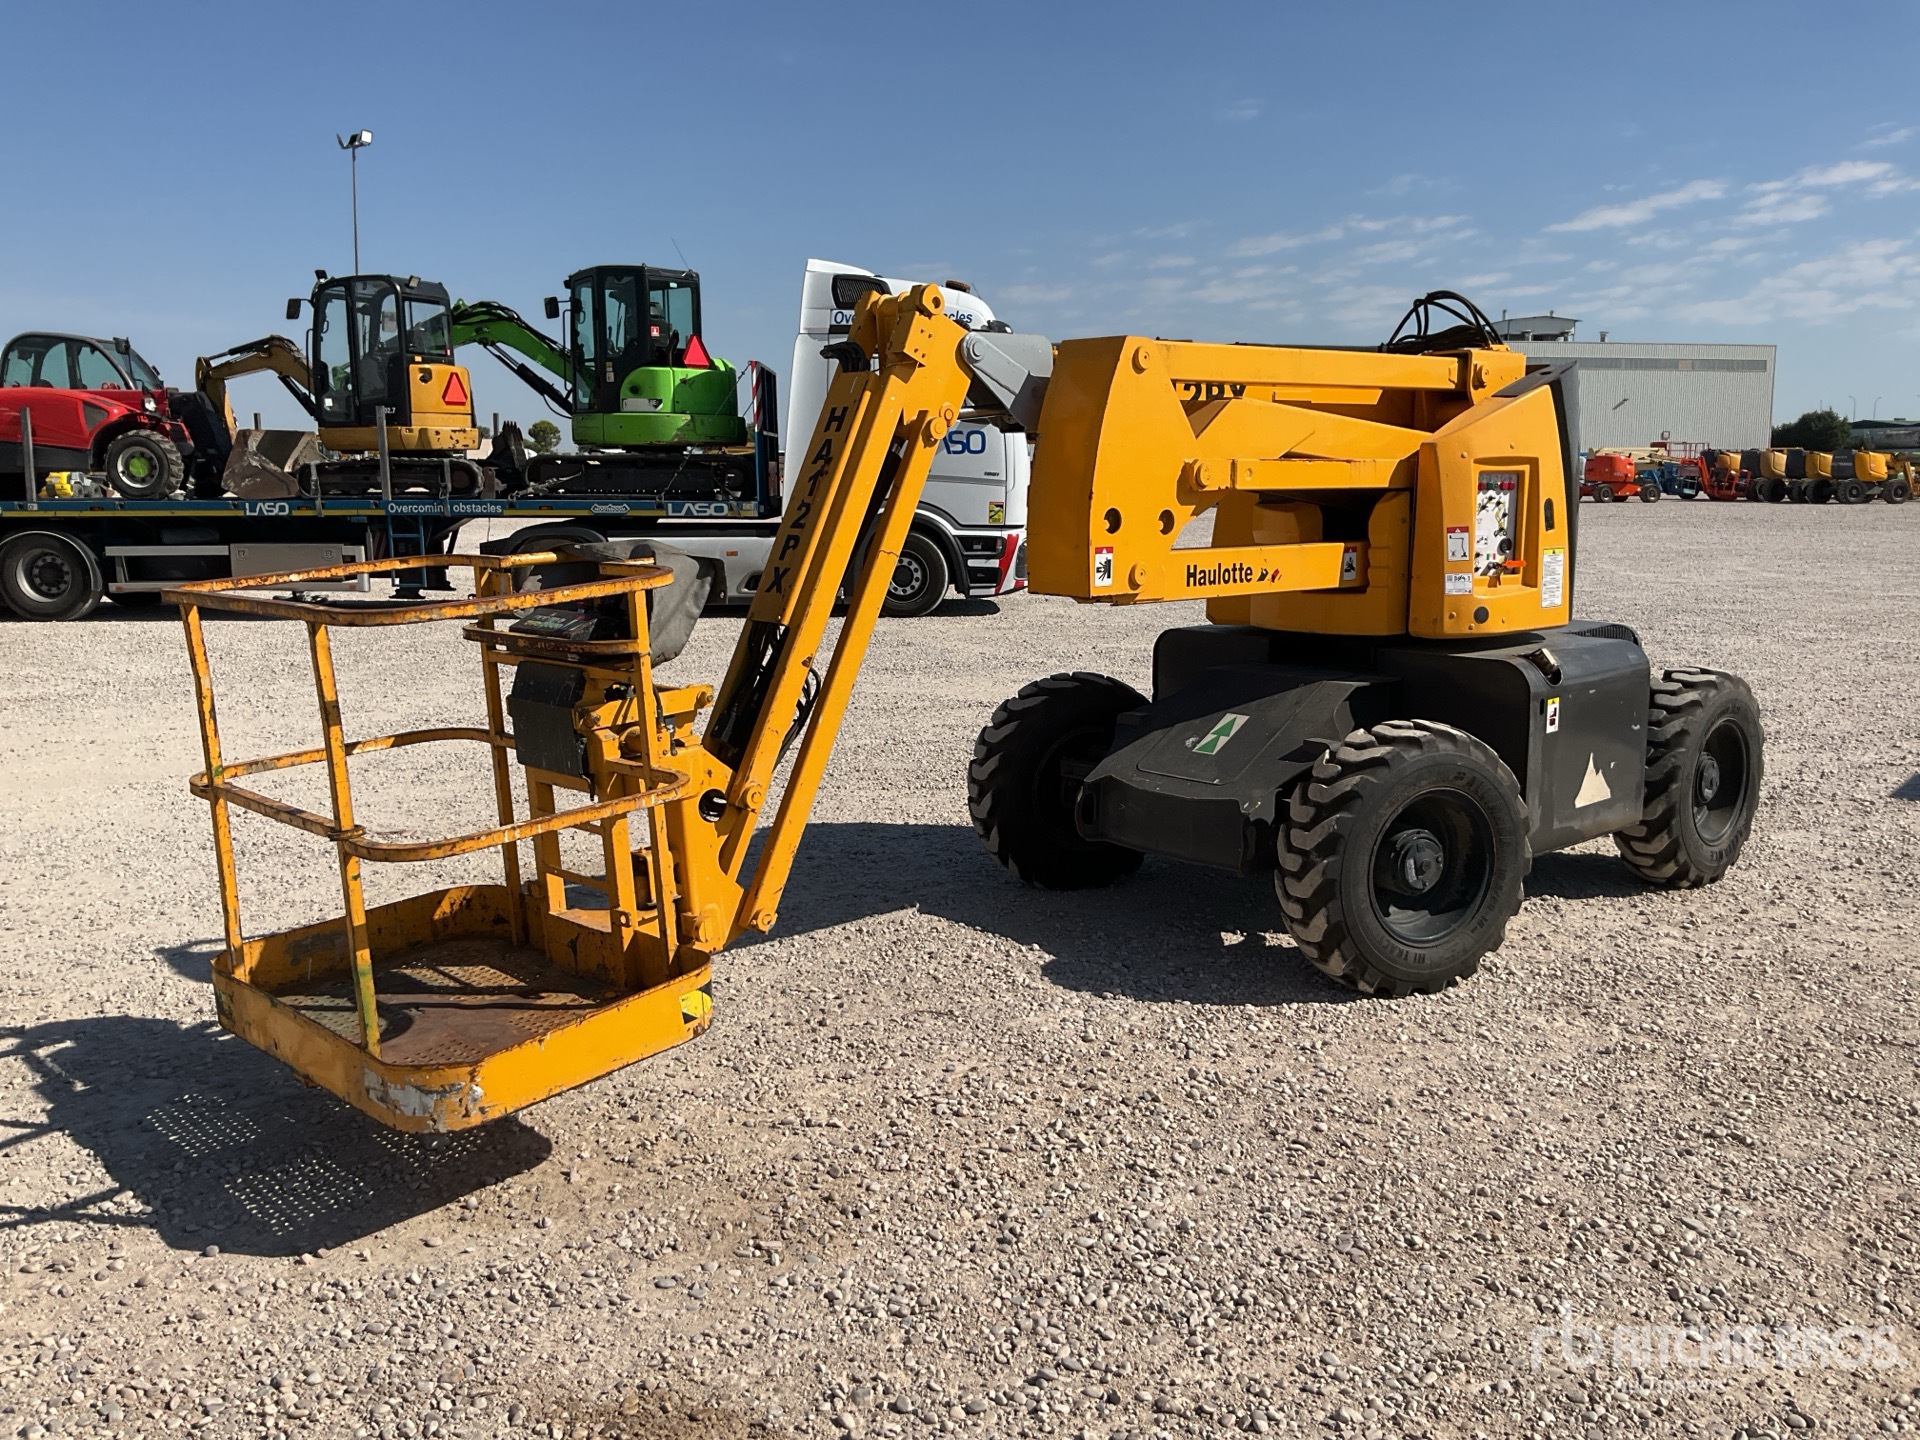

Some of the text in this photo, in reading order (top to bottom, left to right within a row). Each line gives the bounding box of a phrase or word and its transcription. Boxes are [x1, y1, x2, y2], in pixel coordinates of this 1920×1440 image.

[453, 502, 503, 513] obstacles
[765, 406, 849, 595] HA12PX
[245, 502, 290, 516] LASO
[667, 503, 729, 517] LASO
[1186, 562, 1253, 587] Haulotte
